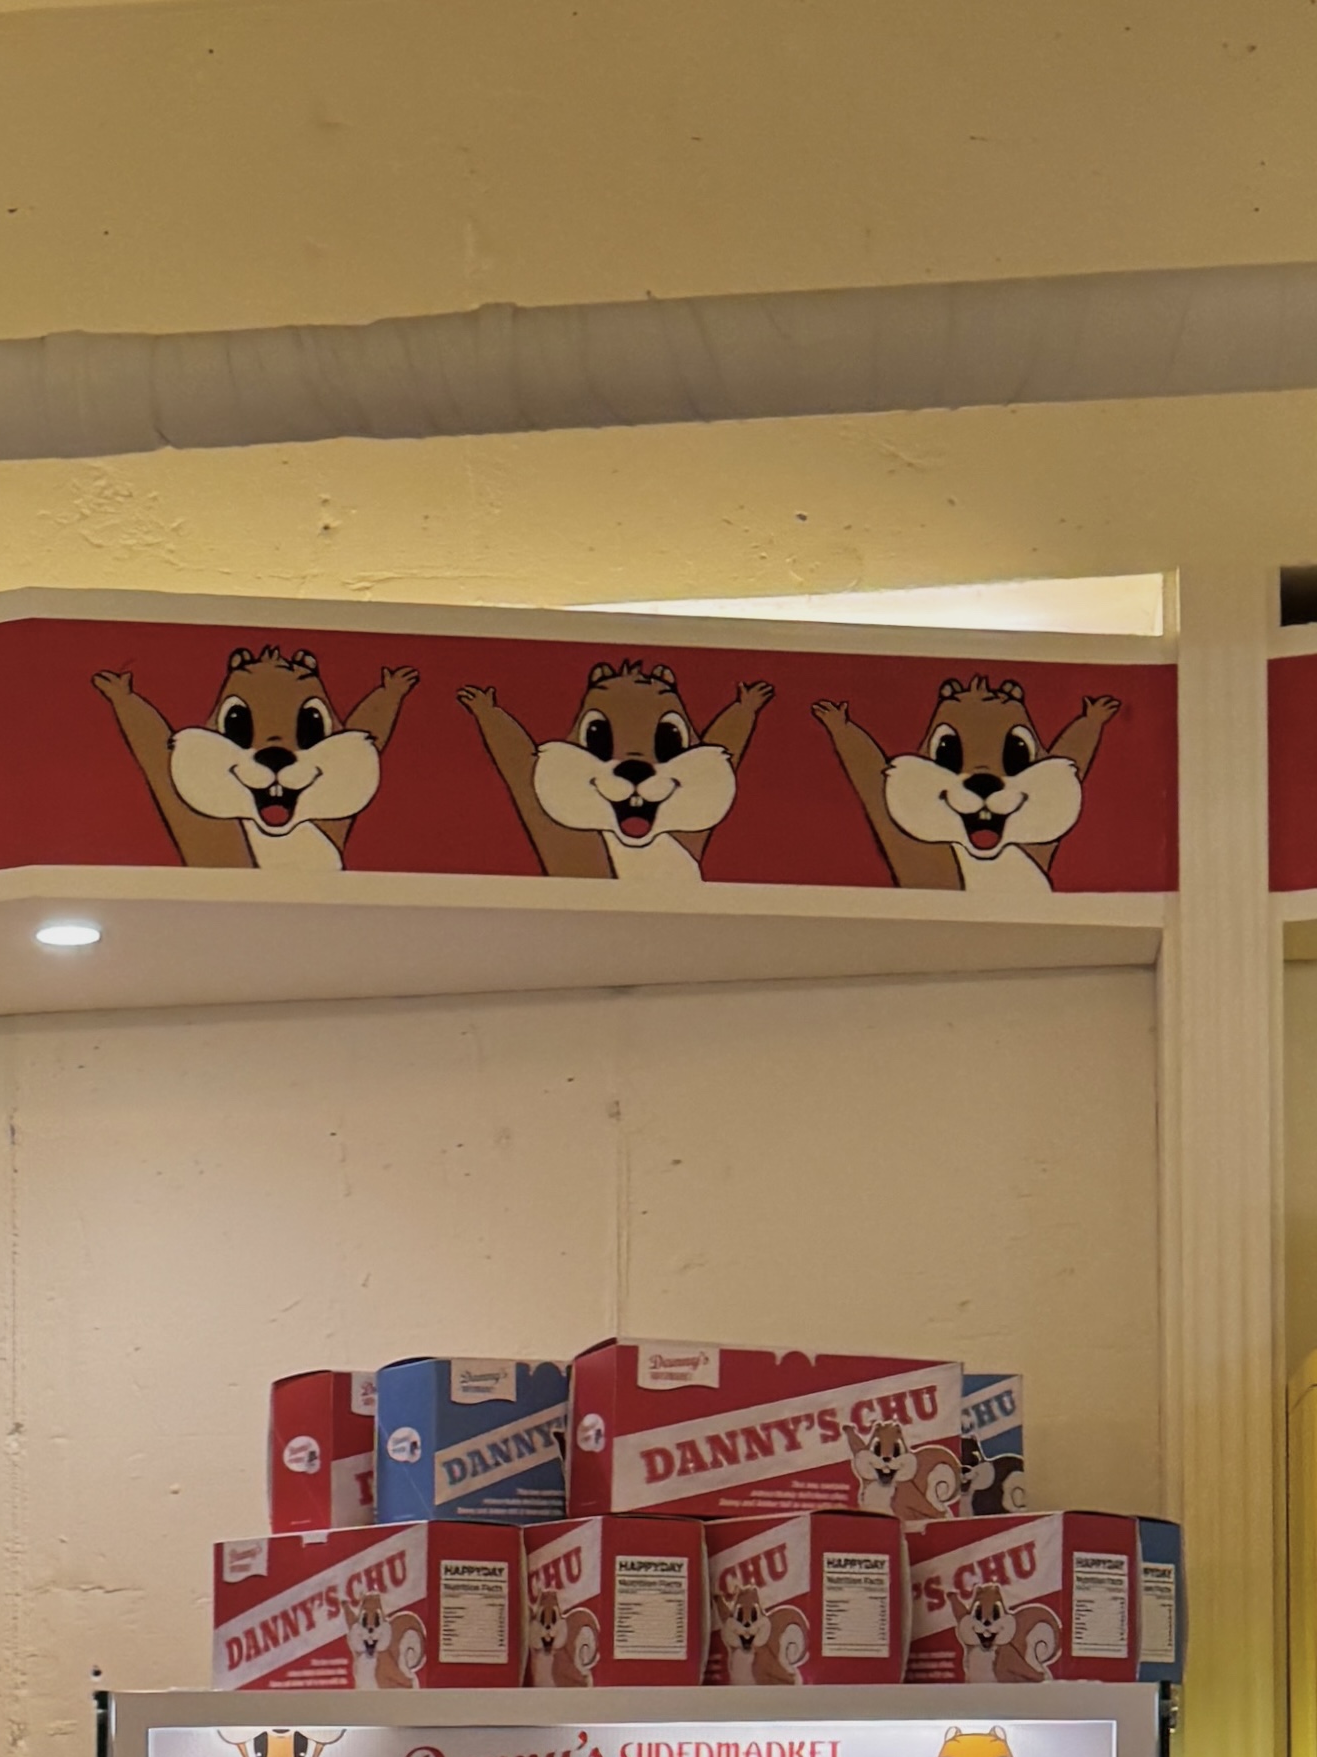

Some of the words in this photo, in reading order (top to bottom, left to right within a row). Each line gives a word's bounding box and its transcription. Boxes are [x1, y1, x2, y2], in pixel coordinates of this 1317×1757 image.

[640, 1406, 842, 1485] DANNY'S
[850, 1384, 940, 1435] CHU
[443, 1564, 506, 1577] HAPPYDAY
[619, 1558, 685, 1574] HAPPYDAY
[718, 1542, 788, 1603] CHU
[826, 1557, 886, 1571] HAPPYDAY
[953, 1540, 1037, 1601] CHU
[1076, 1558, 1127, 1570] HAPPYDAY
[225, 1591, 342, 1671] DANNY'S
[344, 1549, 408, 1608] CHU
